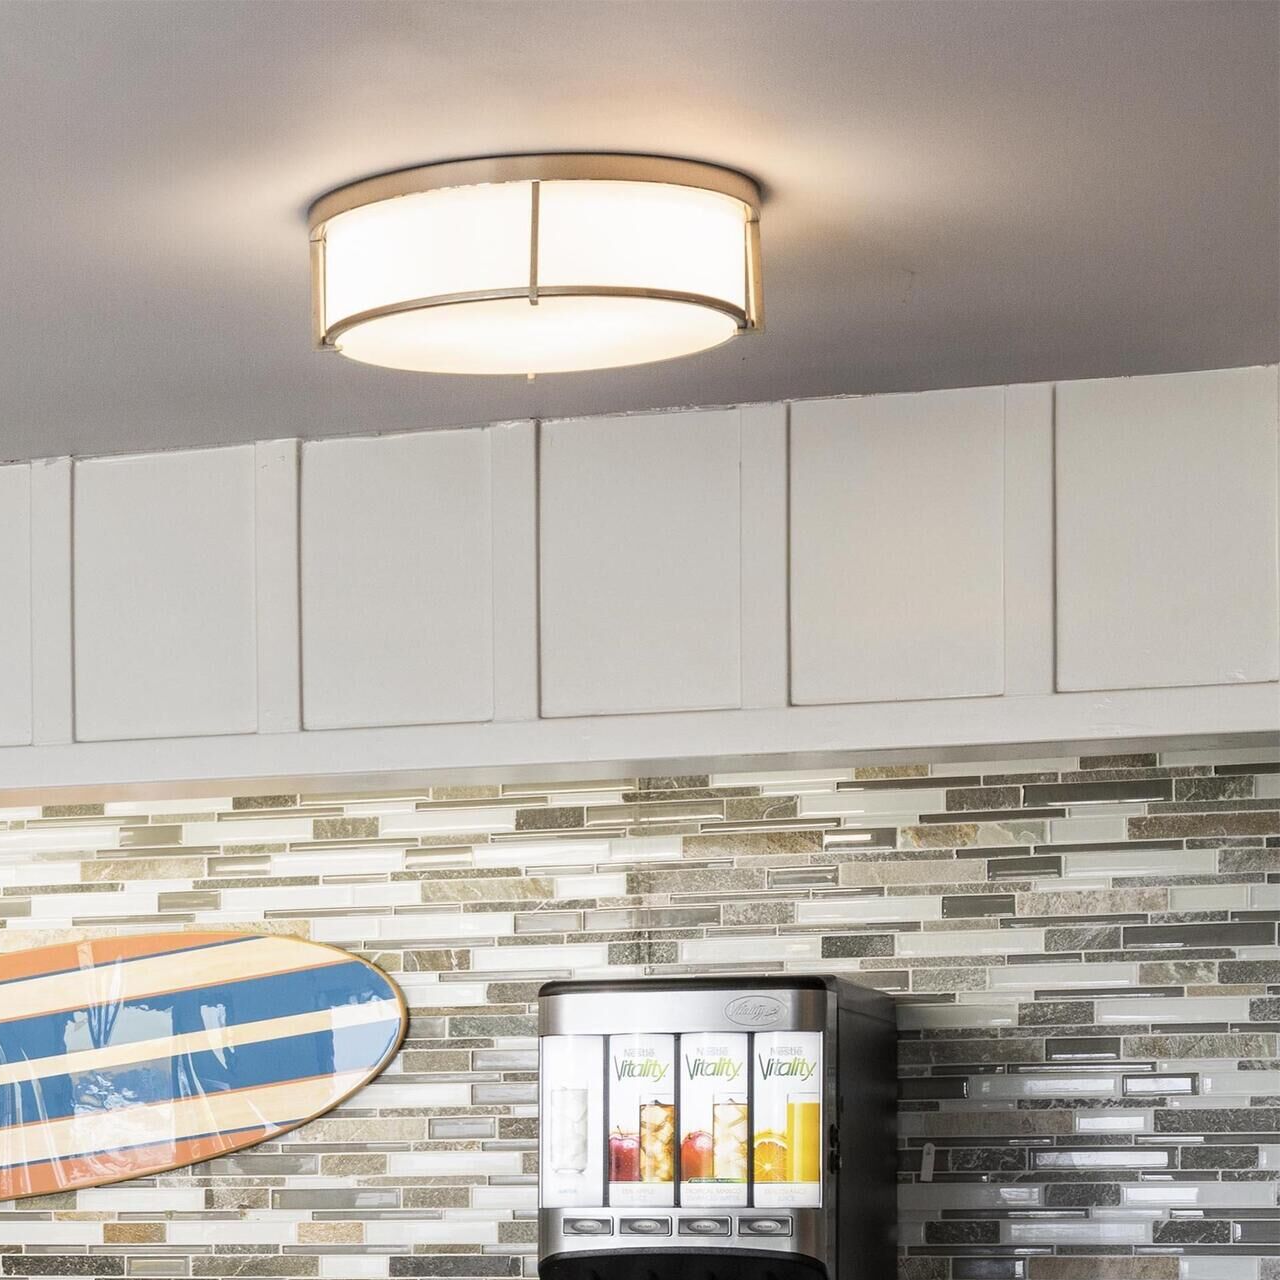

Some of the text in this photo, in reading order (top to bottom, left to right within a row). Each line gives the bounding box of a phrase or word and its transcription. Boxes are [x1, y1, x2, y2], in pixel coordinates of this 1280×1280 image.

[614, 1055, 670, 1082] Vitality
[684, 1053, 743, 1082] Vitality
[758, 1053, 817, 1082] Vitality
